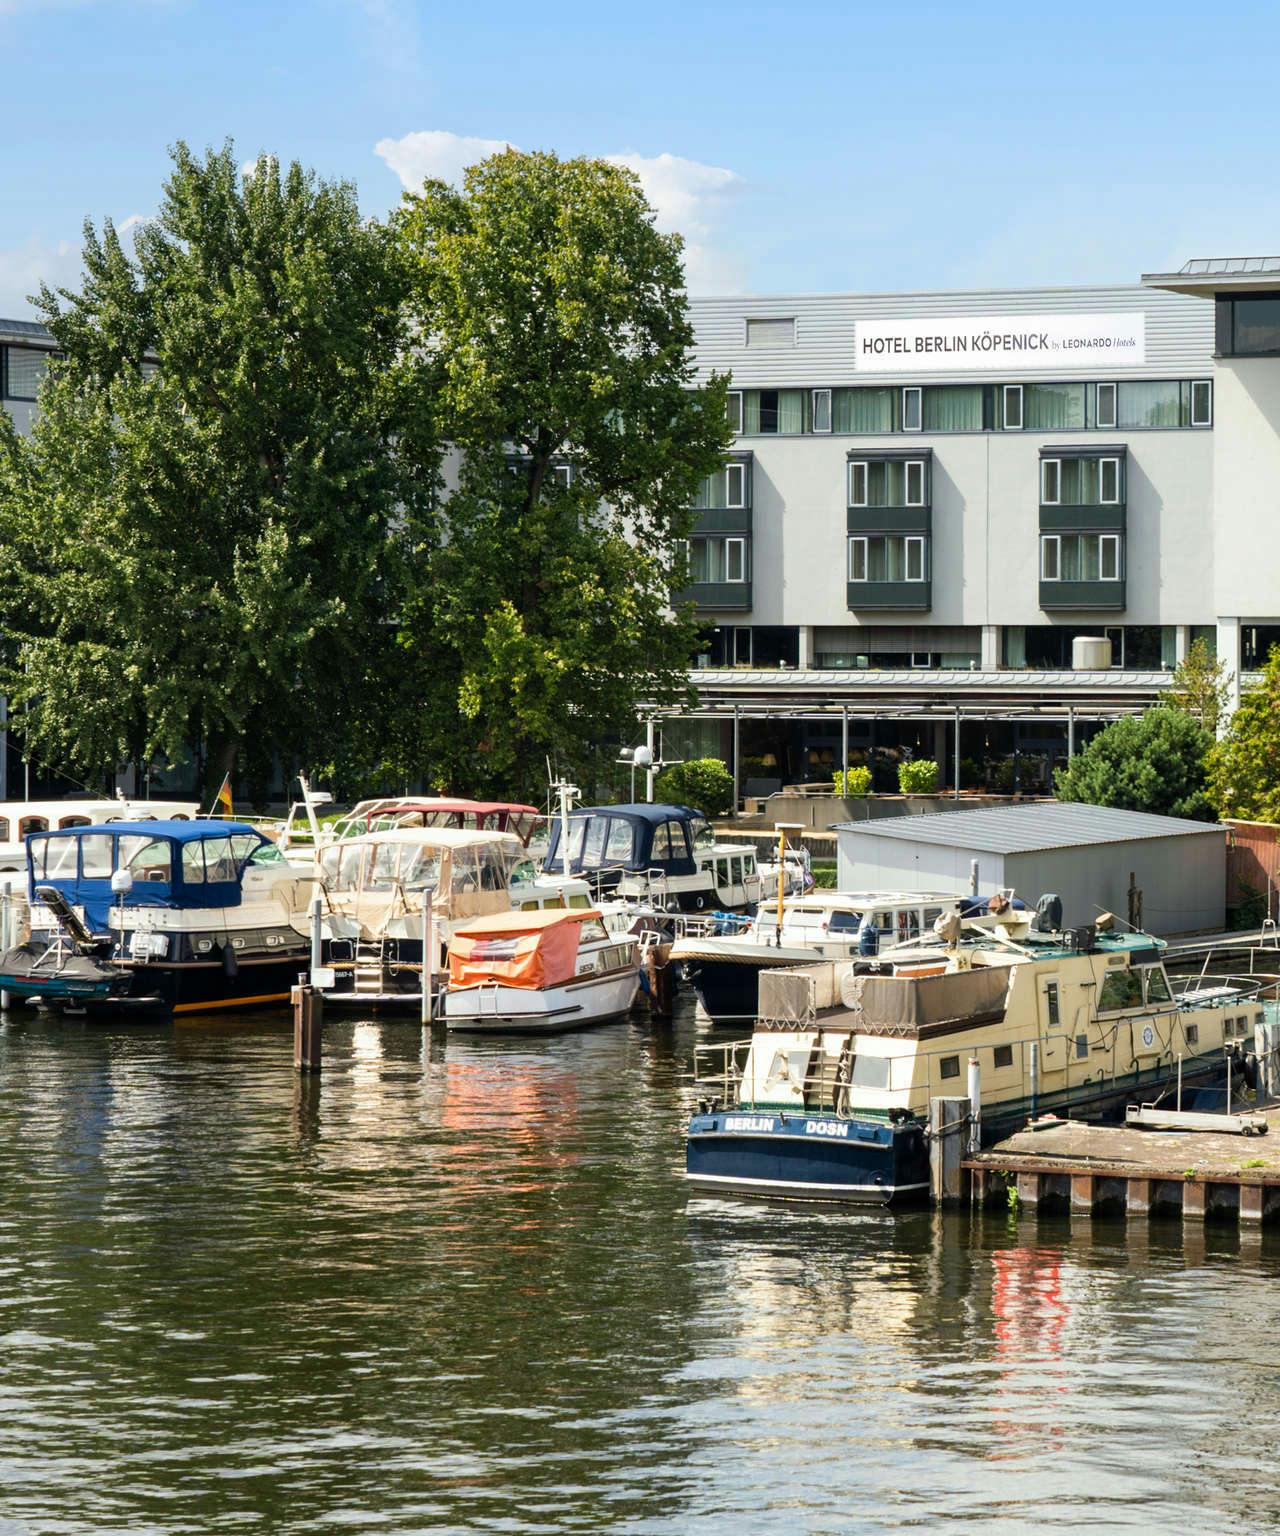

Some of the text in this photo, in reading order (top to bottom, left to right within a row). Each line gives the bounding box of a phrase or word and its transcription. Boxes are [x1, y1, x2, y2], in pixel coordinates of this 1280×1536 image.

[862, 330, 1137, 354] HOTEL BERLIN KÖPENICK by LEONARDO Hotels
[725, 1118, 848, 1136] BERLIN DOSN
